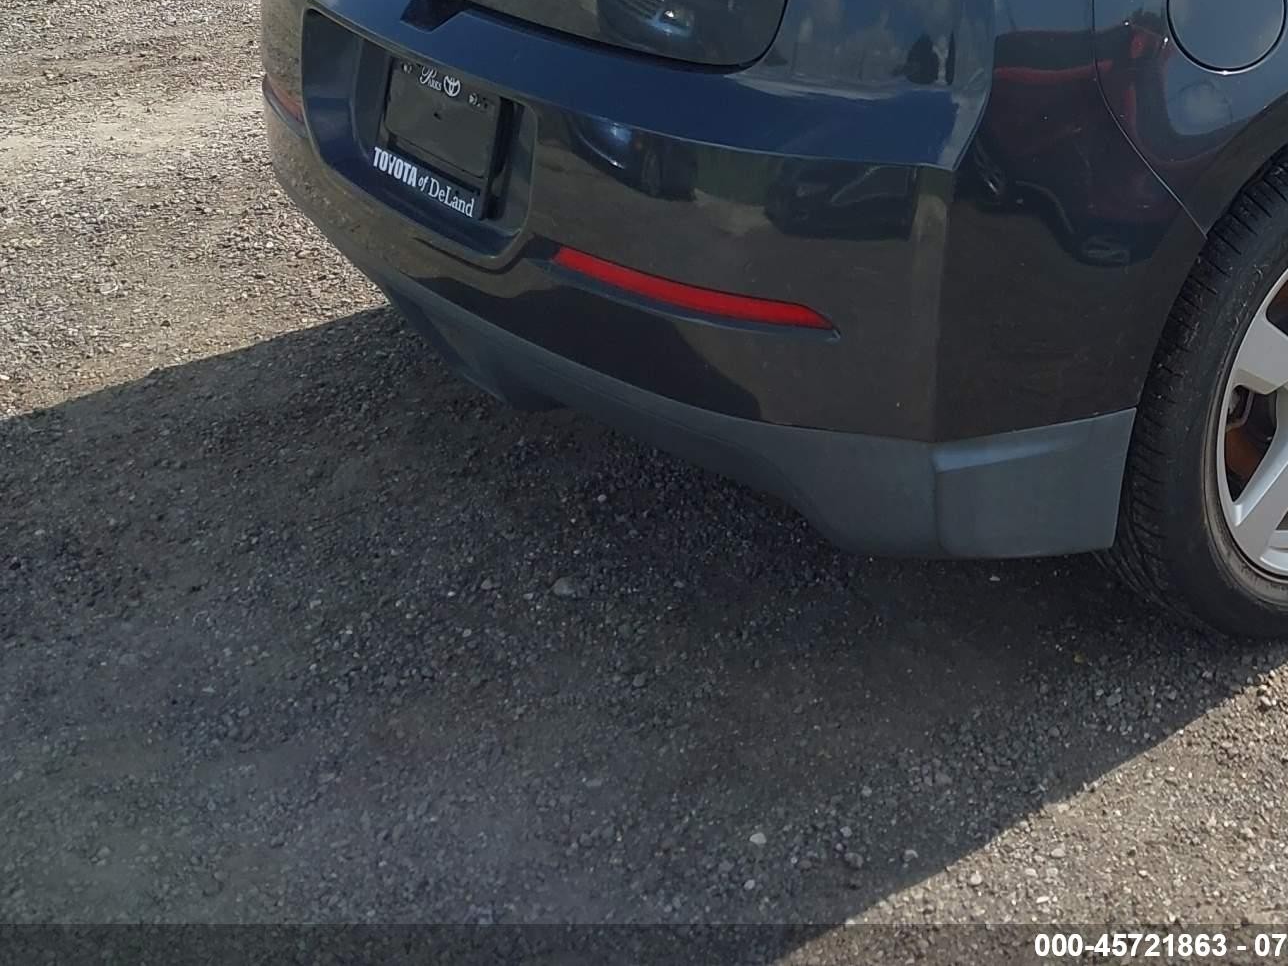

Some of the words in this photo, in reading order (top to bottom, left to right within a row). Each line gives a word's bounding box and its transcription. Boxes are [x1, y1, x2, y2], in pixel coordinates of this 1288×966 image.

[373, 146, 418, 188] TOYOTA
[418, 175, 429, 192] of
[428, 177, 475, 218] DeLand
